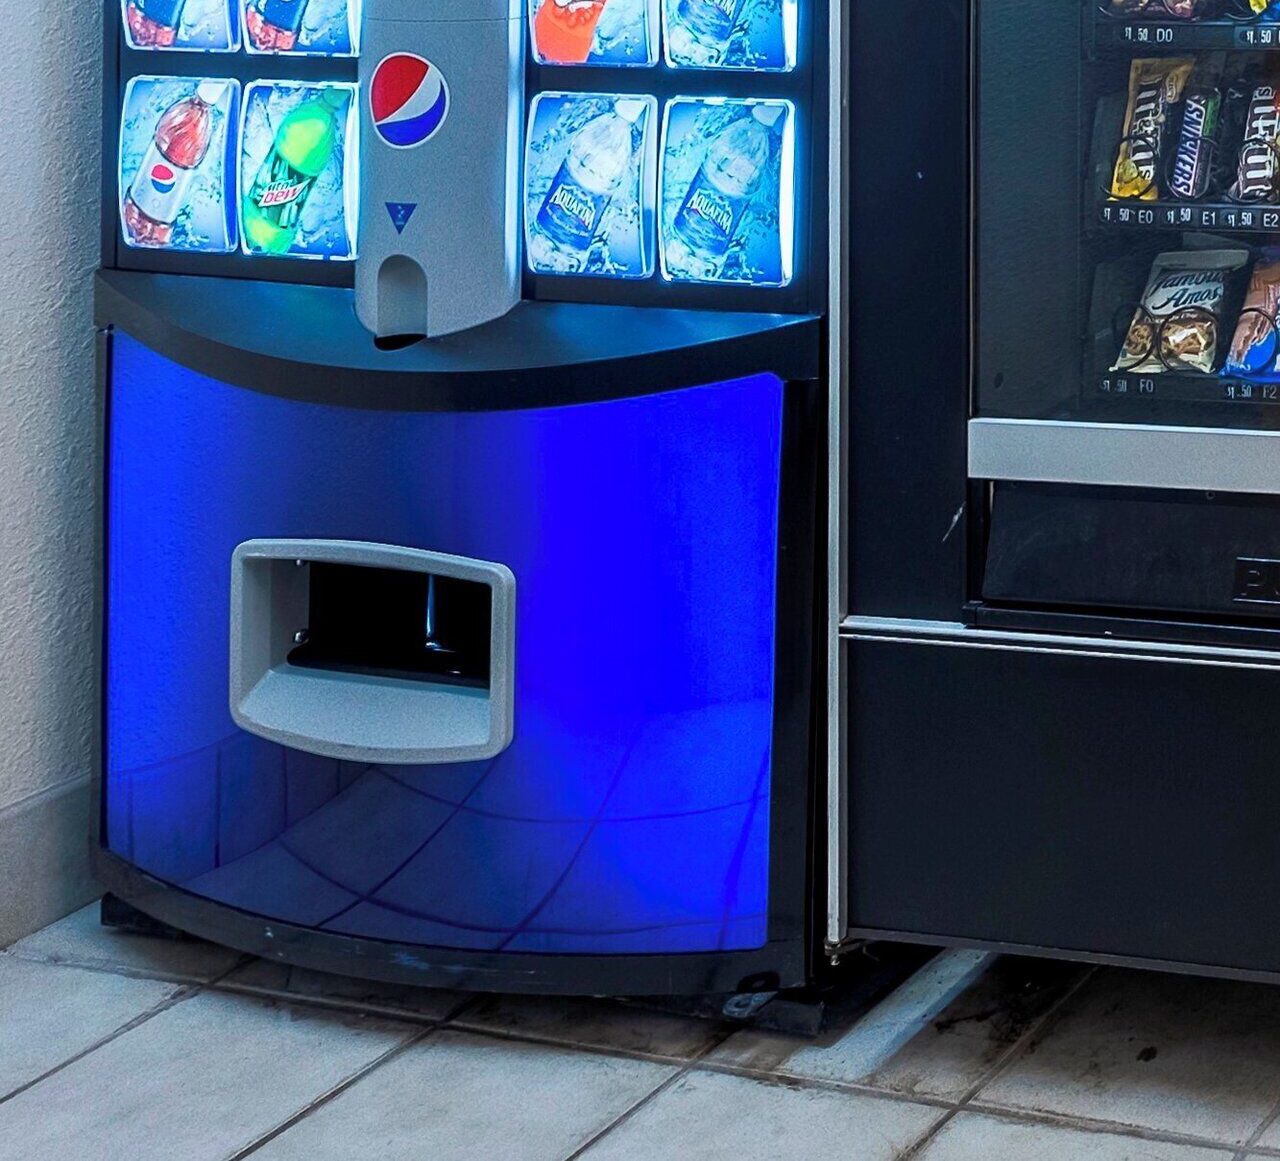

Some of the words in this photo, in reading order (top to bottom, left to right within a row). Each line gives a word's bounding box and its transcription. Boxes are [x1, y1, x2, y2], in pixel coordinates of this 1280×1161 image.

[1156, 28, 1173, 42] D0
[1172, 97, 1206, 197] SNICKERS
[1138, 211, 1153, 224] E0
[1202, 212, 1216, 225] E1
[1263, 214, 1279, 227] E2
[1153, 288, 1221, 309] Amos
